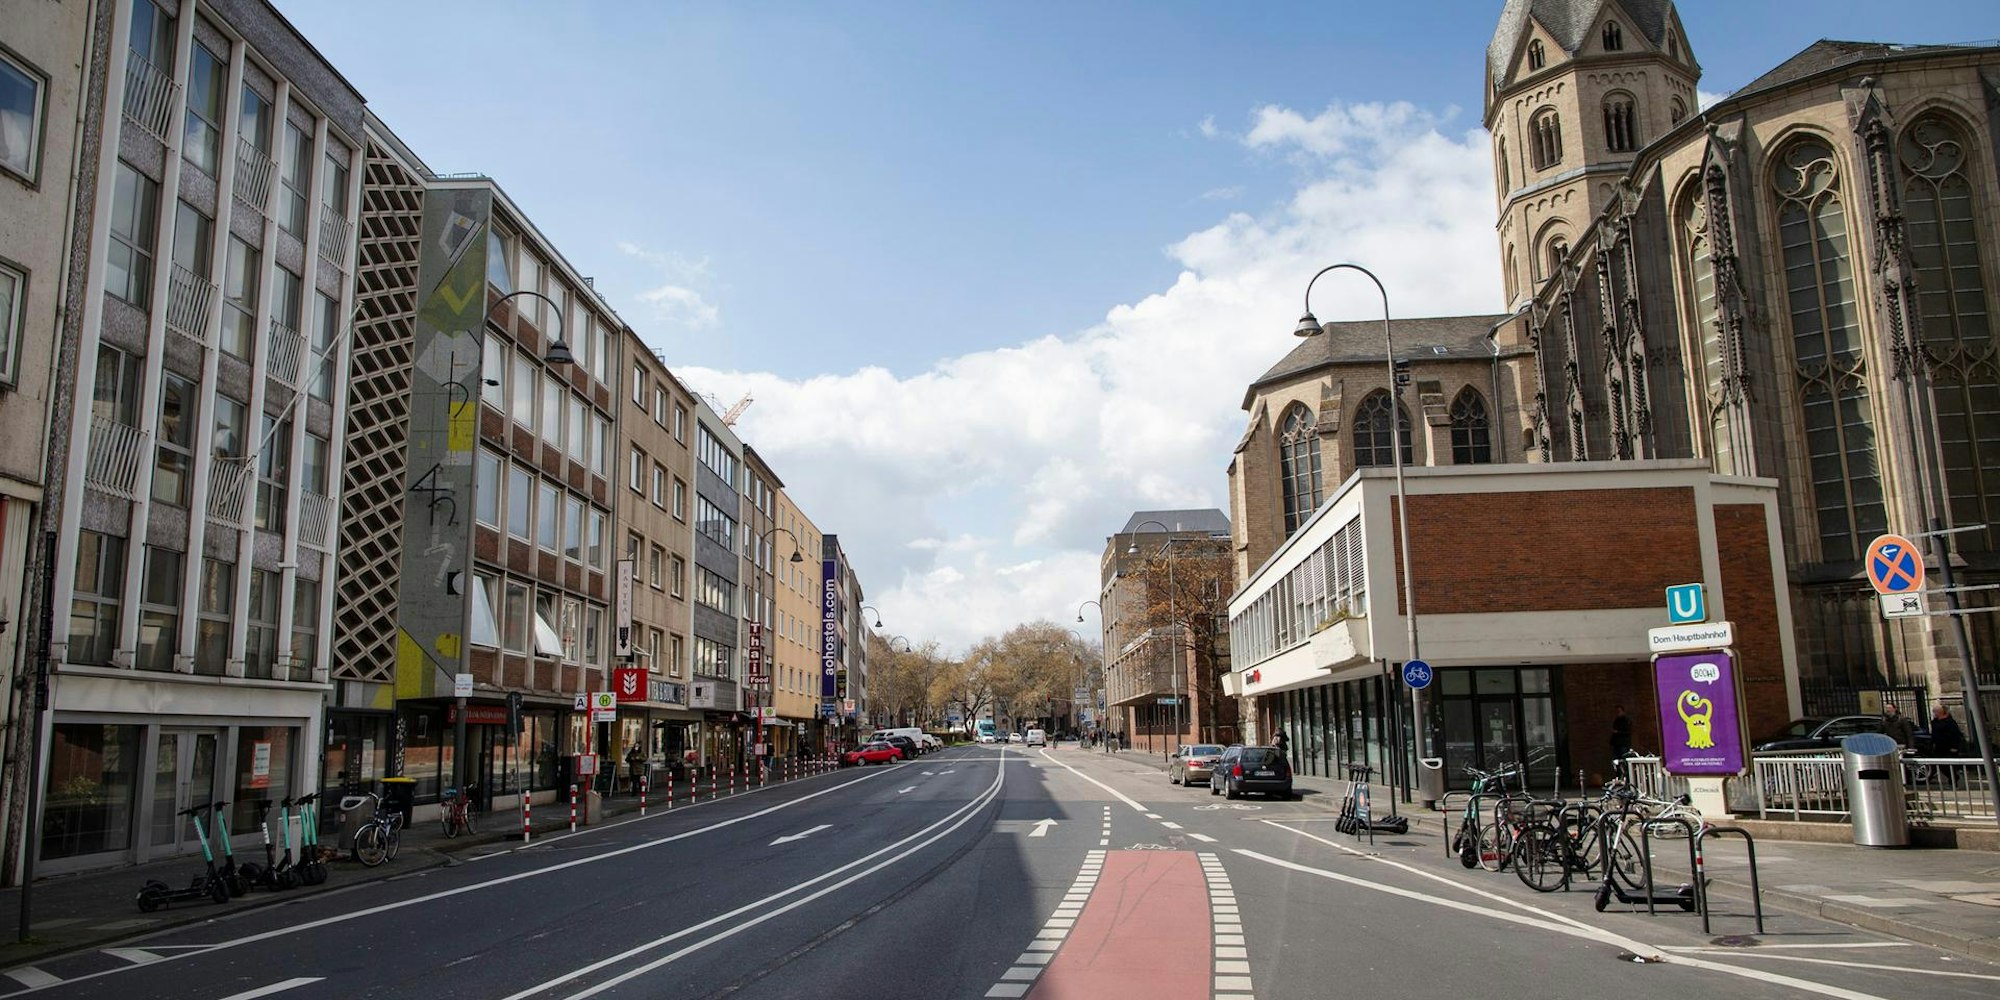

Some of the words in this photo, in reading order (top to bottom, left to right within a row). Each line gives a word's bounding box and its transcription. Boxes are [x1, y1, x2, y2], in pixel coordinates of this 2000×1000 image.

[1674, 589, 1697, 618] U
[823, 579, 834, 676] aohostels.com
[750, 623, 761, 673] Thai
[750, 676, 769, 684] Food
[576, 698, 584, 707] A
